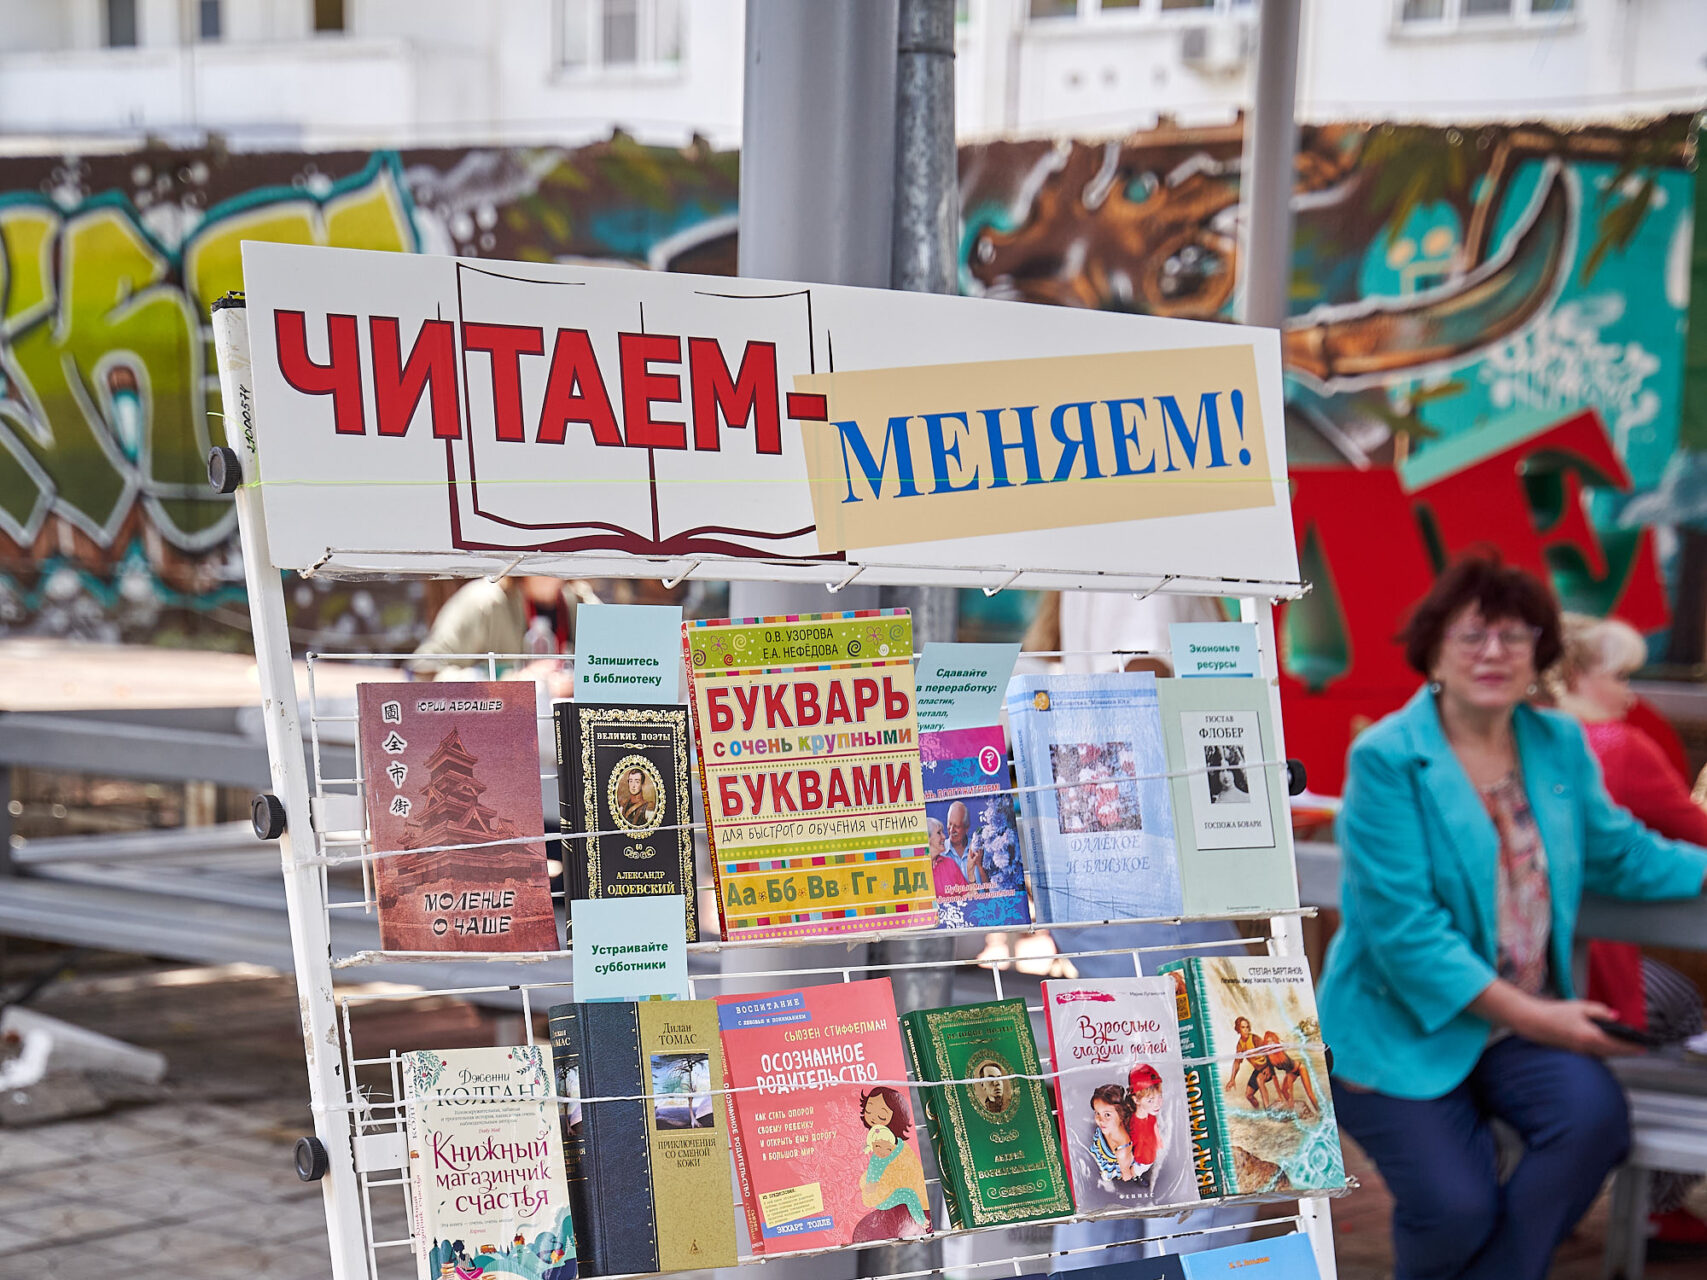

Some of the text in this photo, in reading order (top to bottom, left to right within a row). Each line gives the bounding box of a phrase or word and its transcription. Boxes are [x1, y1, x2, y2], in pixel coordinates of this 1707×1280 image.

[273, 308, 828, 455] ЧИТАЕМ-
[829, 388, 1252, 504] МЕНЯЕМ!
[765, 628, 834, 643] О.В. УЗОРОВА
[763, 643, 839, 659] Е.А. НЕФЁДОВА
[1189, 643, 1240, 655] Экономьте
[587, 655, 660, 668] Запишитесь
[1197, 660, 1237, 670] ресурсы
[583, 673, 662, 686] в библиотеку
[936, 668, 988, 679] Сдавайте
[925, 683, 998, 694] переработку:
[705, 675, 910, 734] БУКВАРЬ
[918, 698, 955, 706] пластик,
[597, 732, 671, 742] ВЕЛИКИЕ ПОЭТЫ
[1199, 726, 1244, 740] ФЛОБЕР
[712, 727, 912, 757] с очень крупными
[717, 761, 915, 819] БУКВАМИ
[721, 815, 919, 844] ДЛЯ БЫСТРОГО ОБУЧЕНИЯ ЧТЕНИЮ
[1070, 834, 1141, 852] ДАЛЁКОЕ
[616, 871, 666, 881] АЛЕКСАНДР
[607, 881, 676, 895] ОДОЕВСКИЙ
[727, 867, 929, 908] Аа Бб Вв Гг Дд
[424, 890, 516, 912] МОЛЕНИЕ
[432, 916, 513, 936] О ЧАШЕ
[591, 941, 669, 957] Устраивайте
[594, 959, 667, 975] субботники
[735, 998, 800, 1015] ВОСПИТАНИЕ
[663, 1022, 692, 1036] Дилан
[784, 1019, 888, 1042] СЬЮЗЕН СТИФФЕЛМАН
[1077, 1015, 1160, 1044] Взрослые
[658, 1033, 697, 1046] ТОМАС
[760, 1042, 865, 1073] ОСОЗНАННОЕ
[1072, 1038, 1167, 1064] глазами детей
[458, 1068, 510, 1085] Дженни
[756, 1062, 878, 1095] РОДИТЕЛЬСТВО
[436, 1083, 536, 1107] КОЛГАН
[755, 1106, 814, 1122] КАК СТАТЬ ОПОРОЙ
[658, 1138, 716, 1151] ПРИКЛЮЧЕНИЯ
[766, 1136, 793, 1147] ОТКРЫТЬ
[795, 1134, 809, 1145] ЕМУ
[811, 1130, 837, 1143] ДОРОГУ
[424, 1130, 549, 1172] Книжный
[665, 1147, 711, 1159] СО СМЕНОЙ
[677, 1157, 701, 1168] КОЖИ
[435, 1163, 552, 1195] магазинчик
[455, 1187, 551, 1219] счастья
[1119, 1191, 1155, 1200] ФЕНИКС
